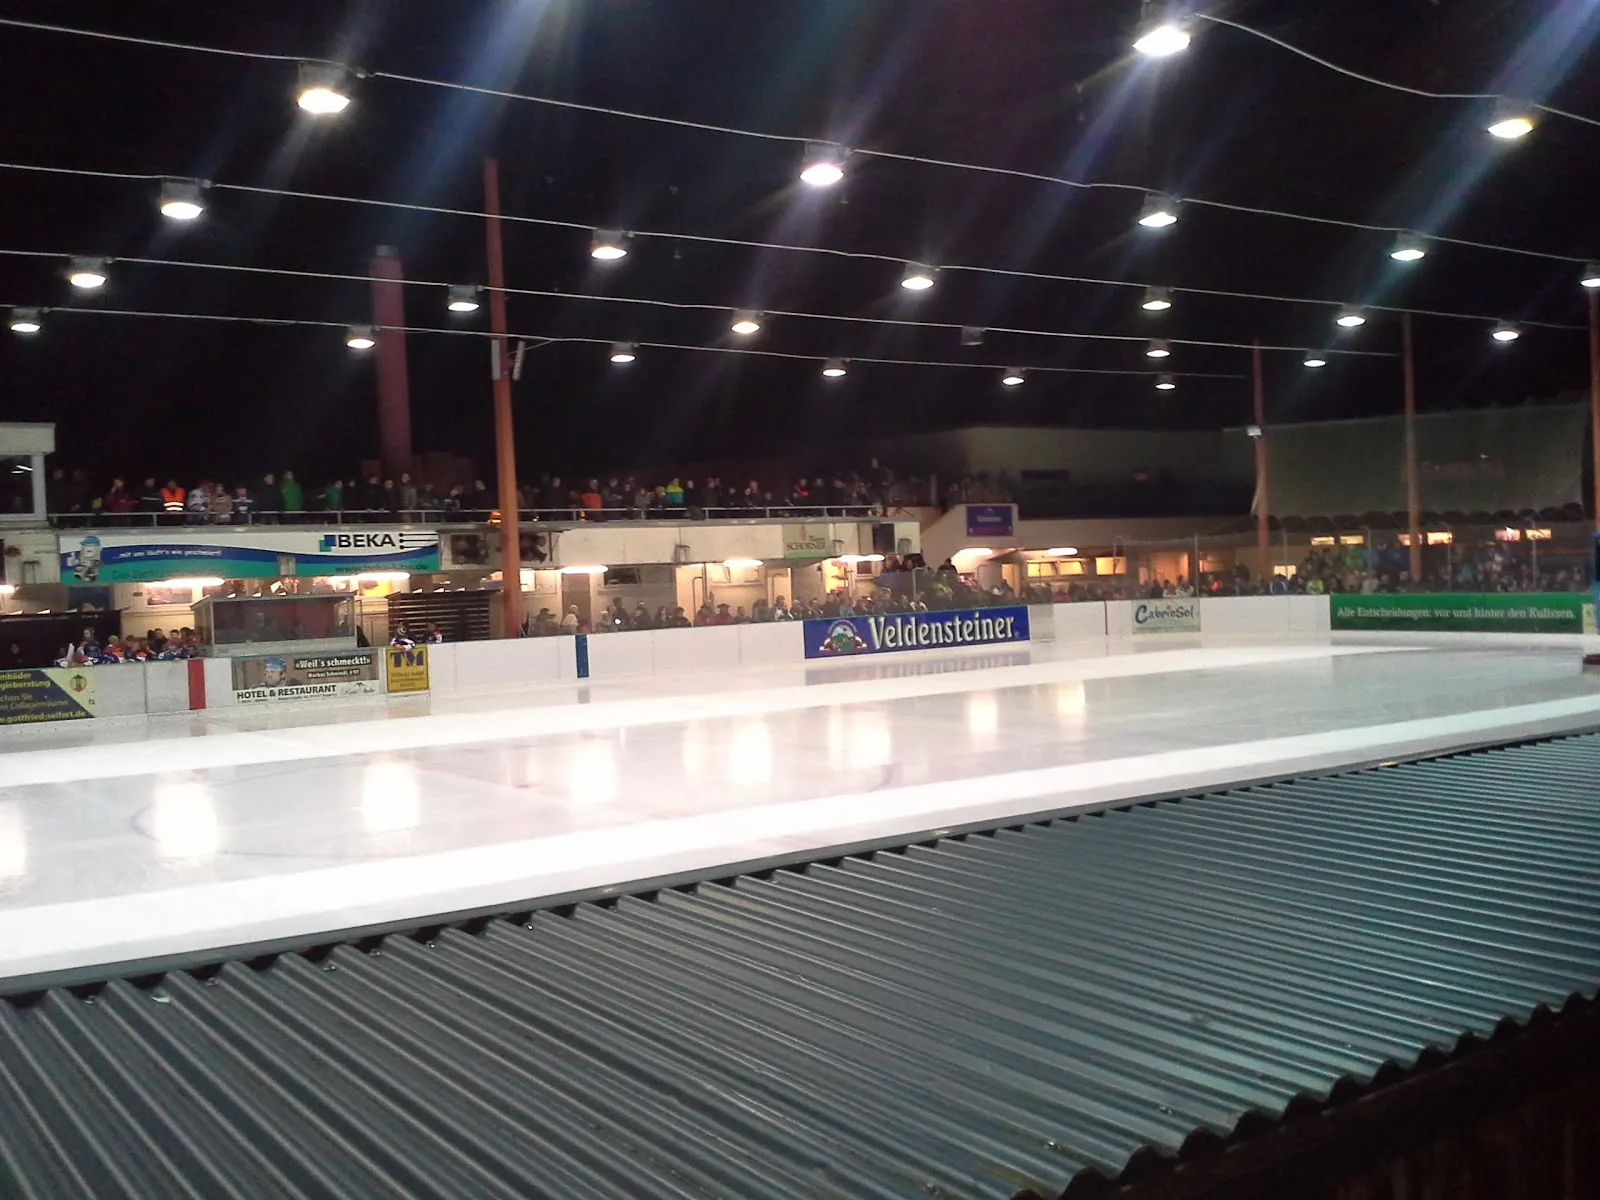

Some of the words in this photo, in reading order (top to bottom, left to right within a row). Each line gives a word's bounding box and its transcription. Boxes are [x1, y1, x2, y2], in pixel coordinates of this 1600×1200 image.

[338, 534, 395, 548] BEKA
[1338, 607, 1355, 617] Alle
[1434, 608, 1450, 617] vor
[1452, 607, 1472, 618] und
[1474, 606, 1504, 618] hinter
[1507, 607, 1526, 618] den
[868, 611, 1014, 650] Veldensteiner
[390, 650, 424, 668] TM
[237, 690, 267, 699] HOTEL
[269, 689, 276, 697] &
[279, 684, 336, 697] RESTAURANT
